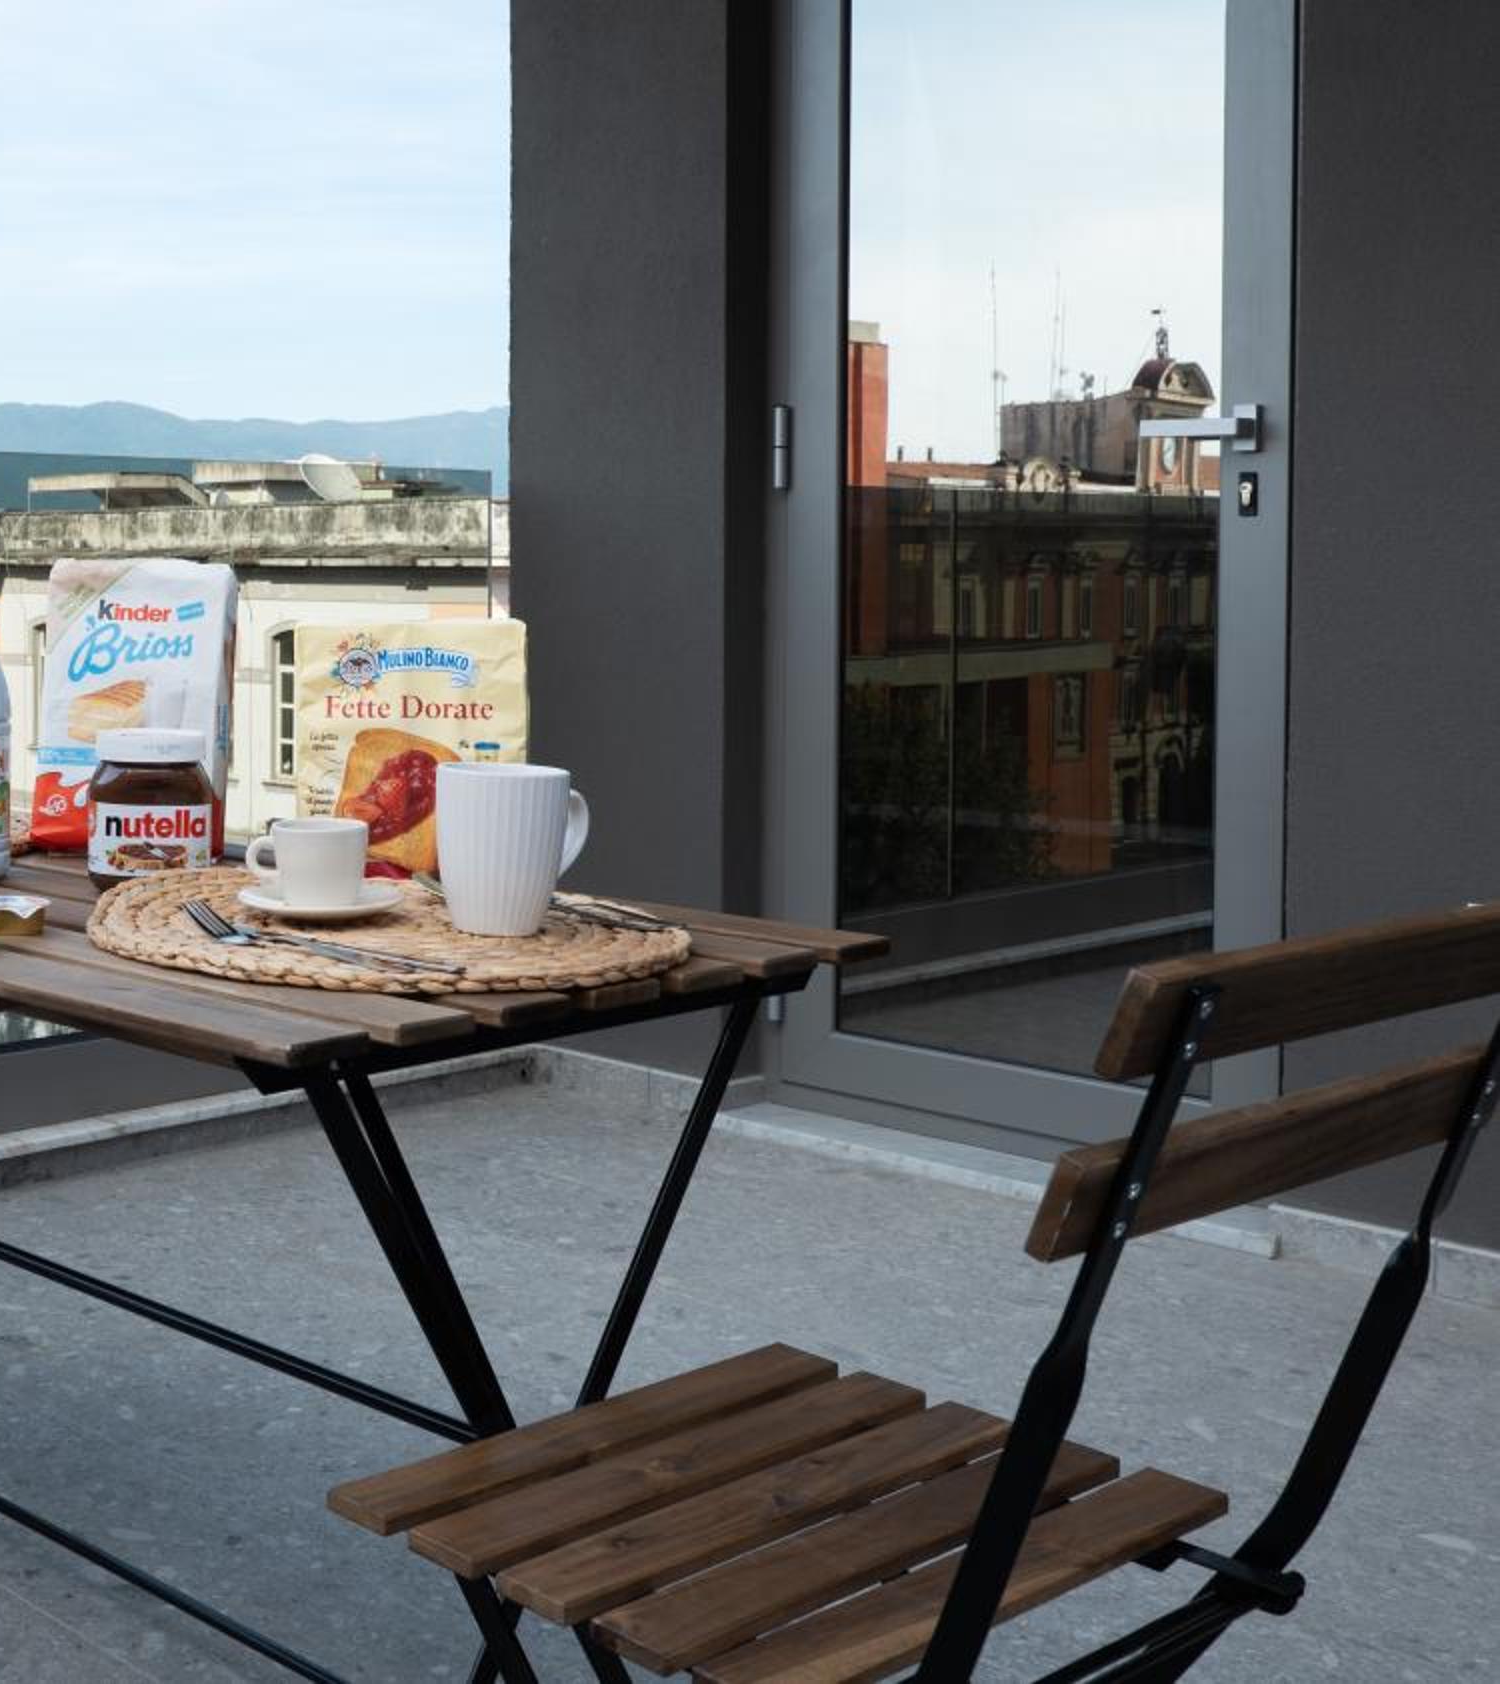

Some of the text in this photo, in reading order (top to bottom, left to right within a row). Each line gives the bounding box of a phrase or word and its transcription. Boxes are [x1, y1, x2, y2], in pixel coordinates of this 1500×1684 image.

[98, 599, 172, 622] kinder
[68, 622, 194, 682] Brioss
[377, 647, 469, 671] MULINO BIANCO
[324, 695, 493, 720] Fette Dorate
[105, 809, 206, 838] nutella
